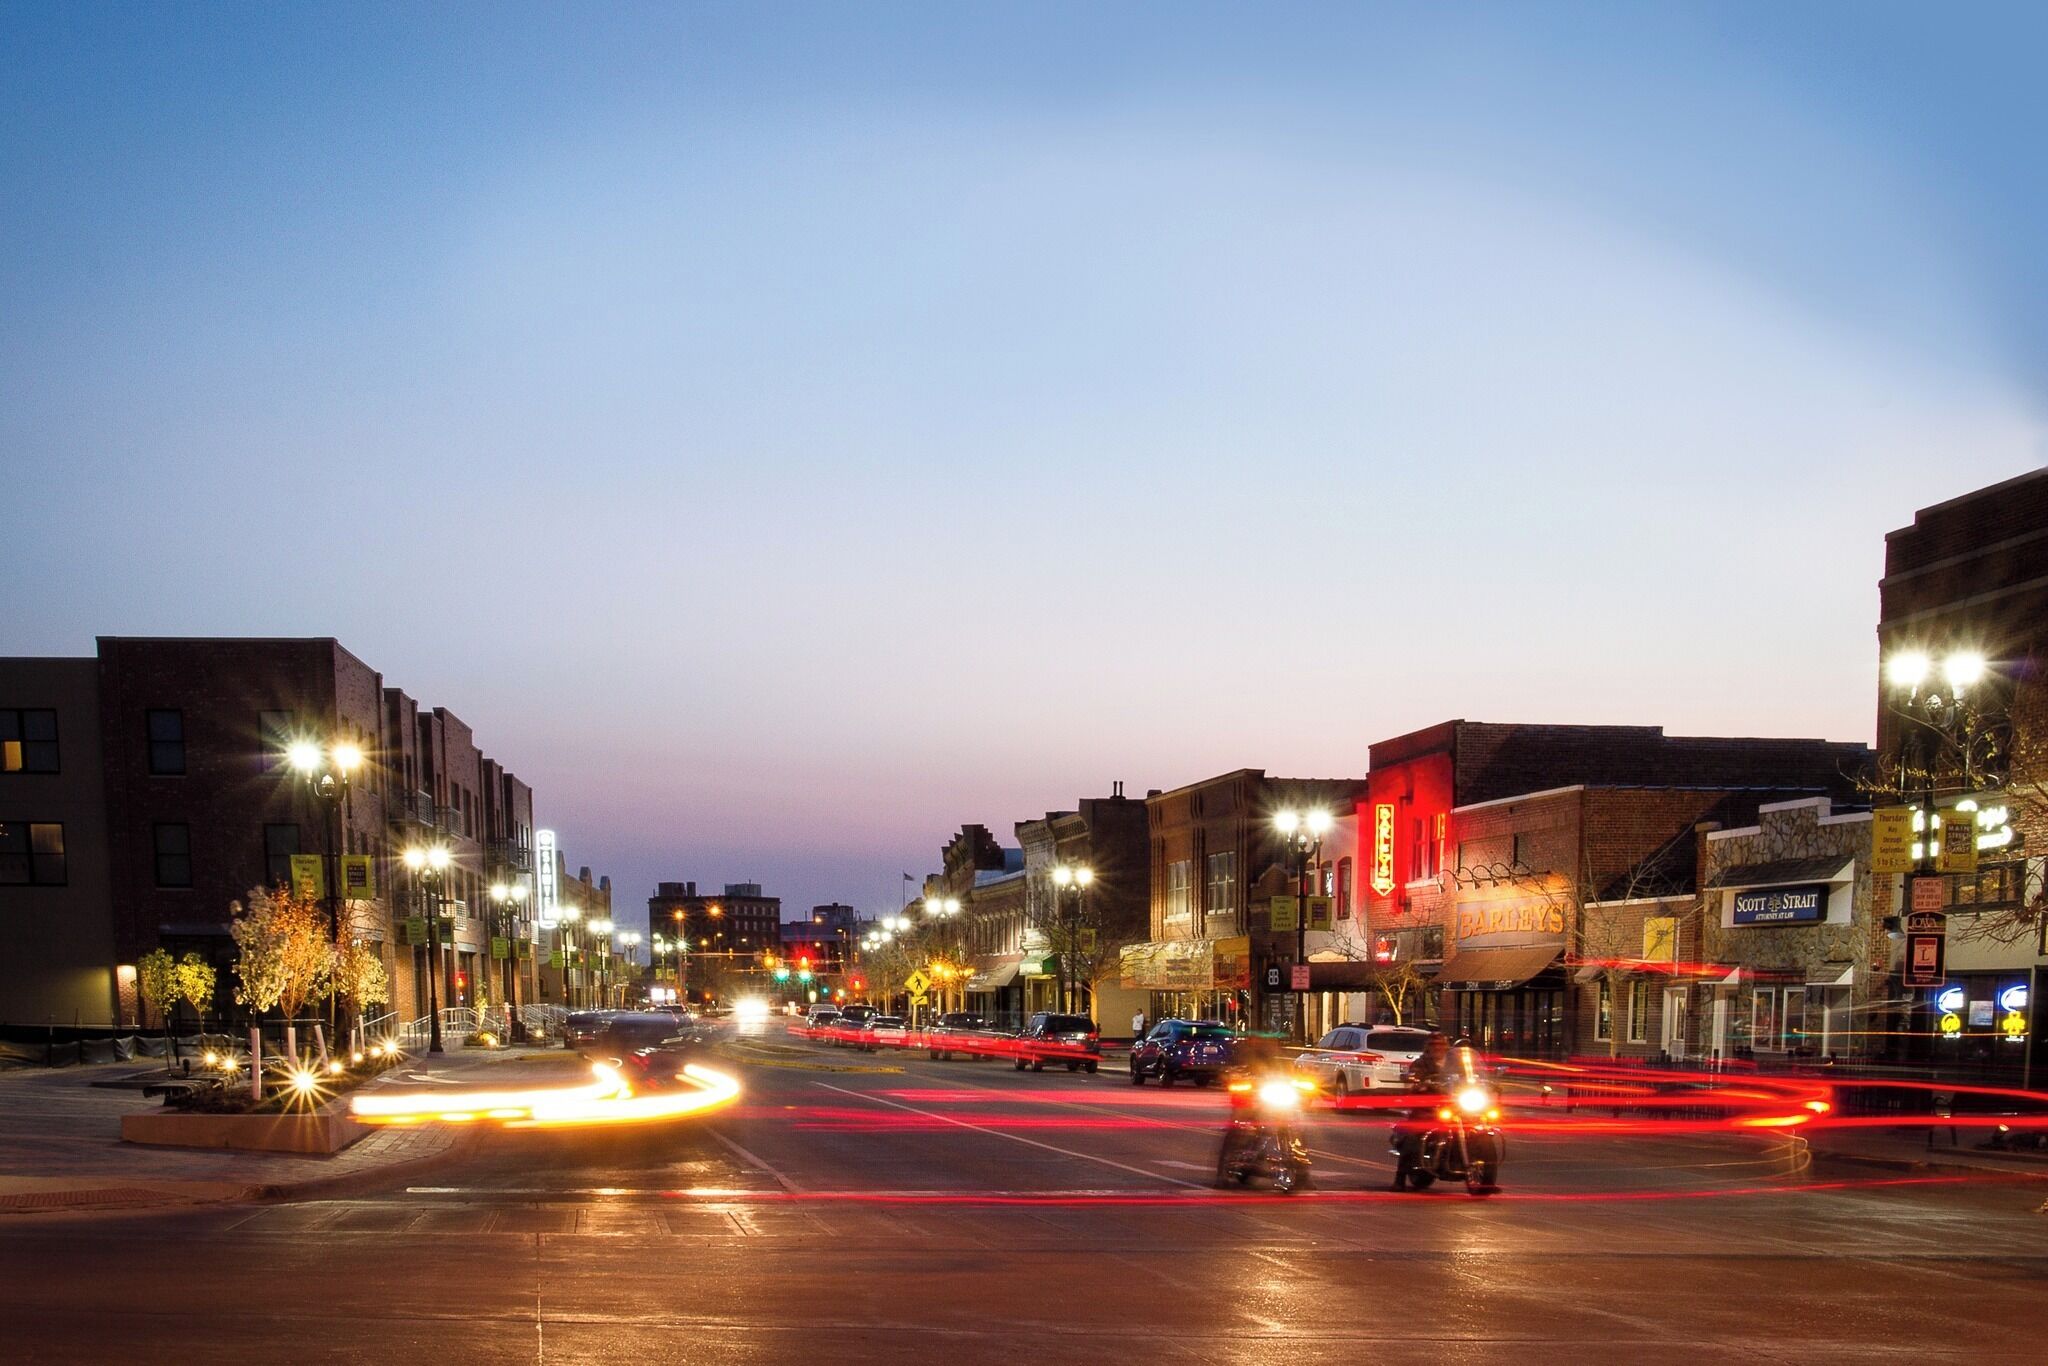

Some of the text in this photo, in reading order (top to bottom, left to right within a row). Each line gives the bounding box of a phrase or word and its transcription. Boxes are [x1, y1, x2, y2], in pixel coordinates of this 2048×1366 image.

[1879, 814, 1908, 824] Thursdays
[1736, 893, 1818, 912] SCOTT STRAIT
[1460, 904, 1565, 939] BARLEYS
[1755, 912, 1778, 920] ATTORNEY
[1784, 911, 1794, 919] LAW
